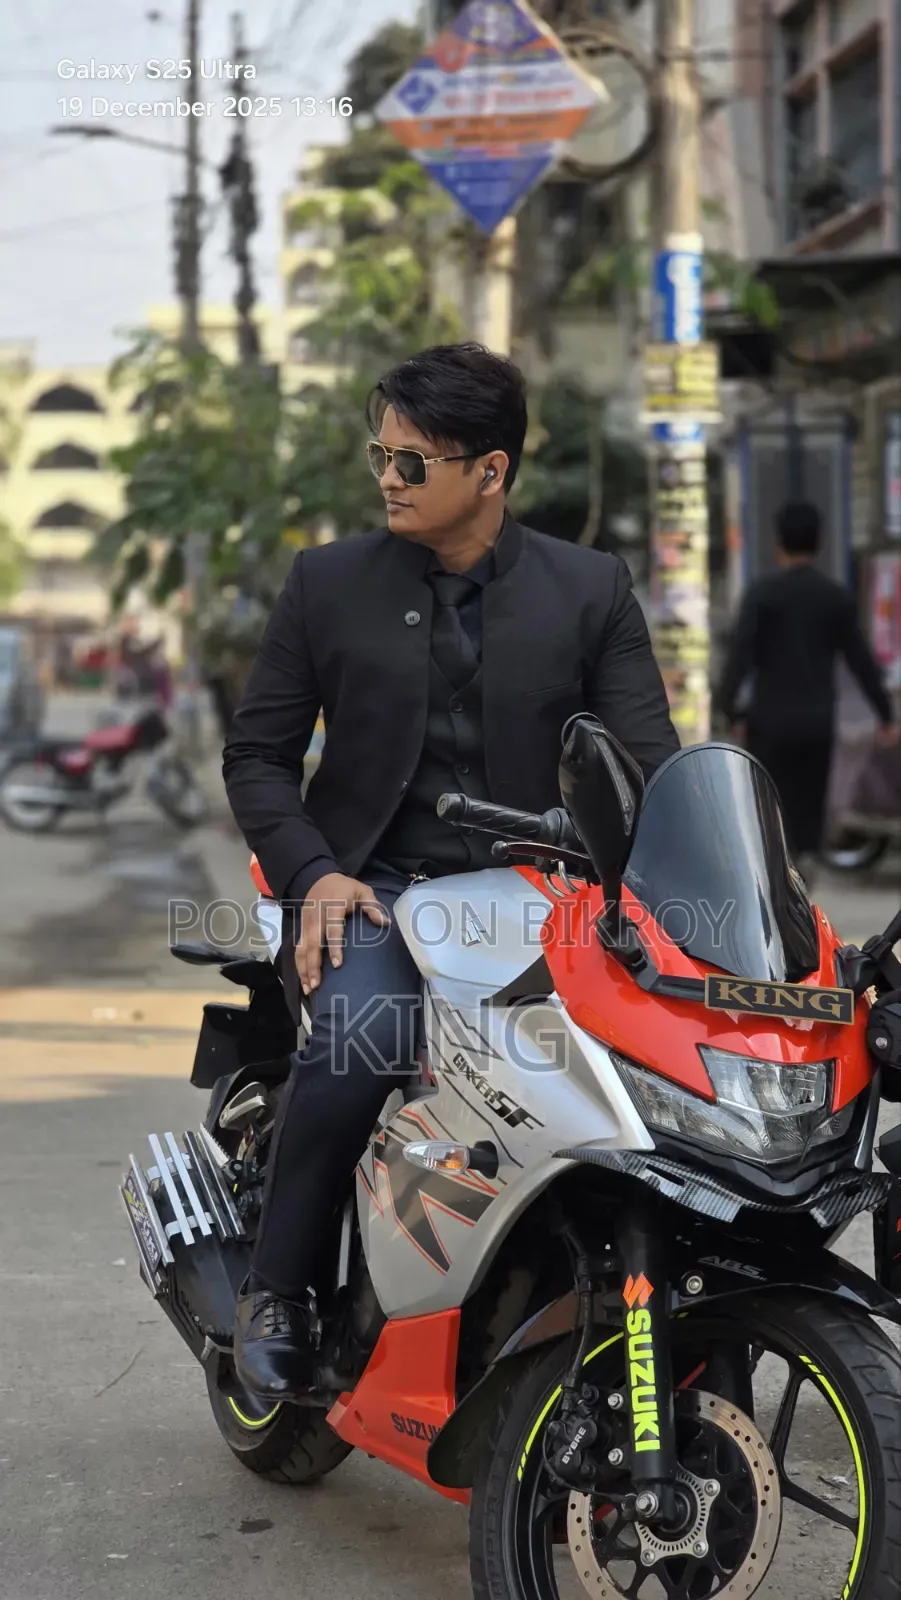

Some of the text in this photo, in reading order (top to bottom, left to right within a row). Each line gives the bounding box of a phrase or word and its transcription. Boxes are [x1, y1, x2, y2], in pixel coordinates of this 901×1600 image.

[715, 980, 845, 1019] KING
[452, 1052, 546, 1130] GIXXER SF
[697, 1255, 765, 1278] ABS
[627, 1309, 662, 1453] SUZUKI
[561, 1426, 587, 1465] BYBRE
